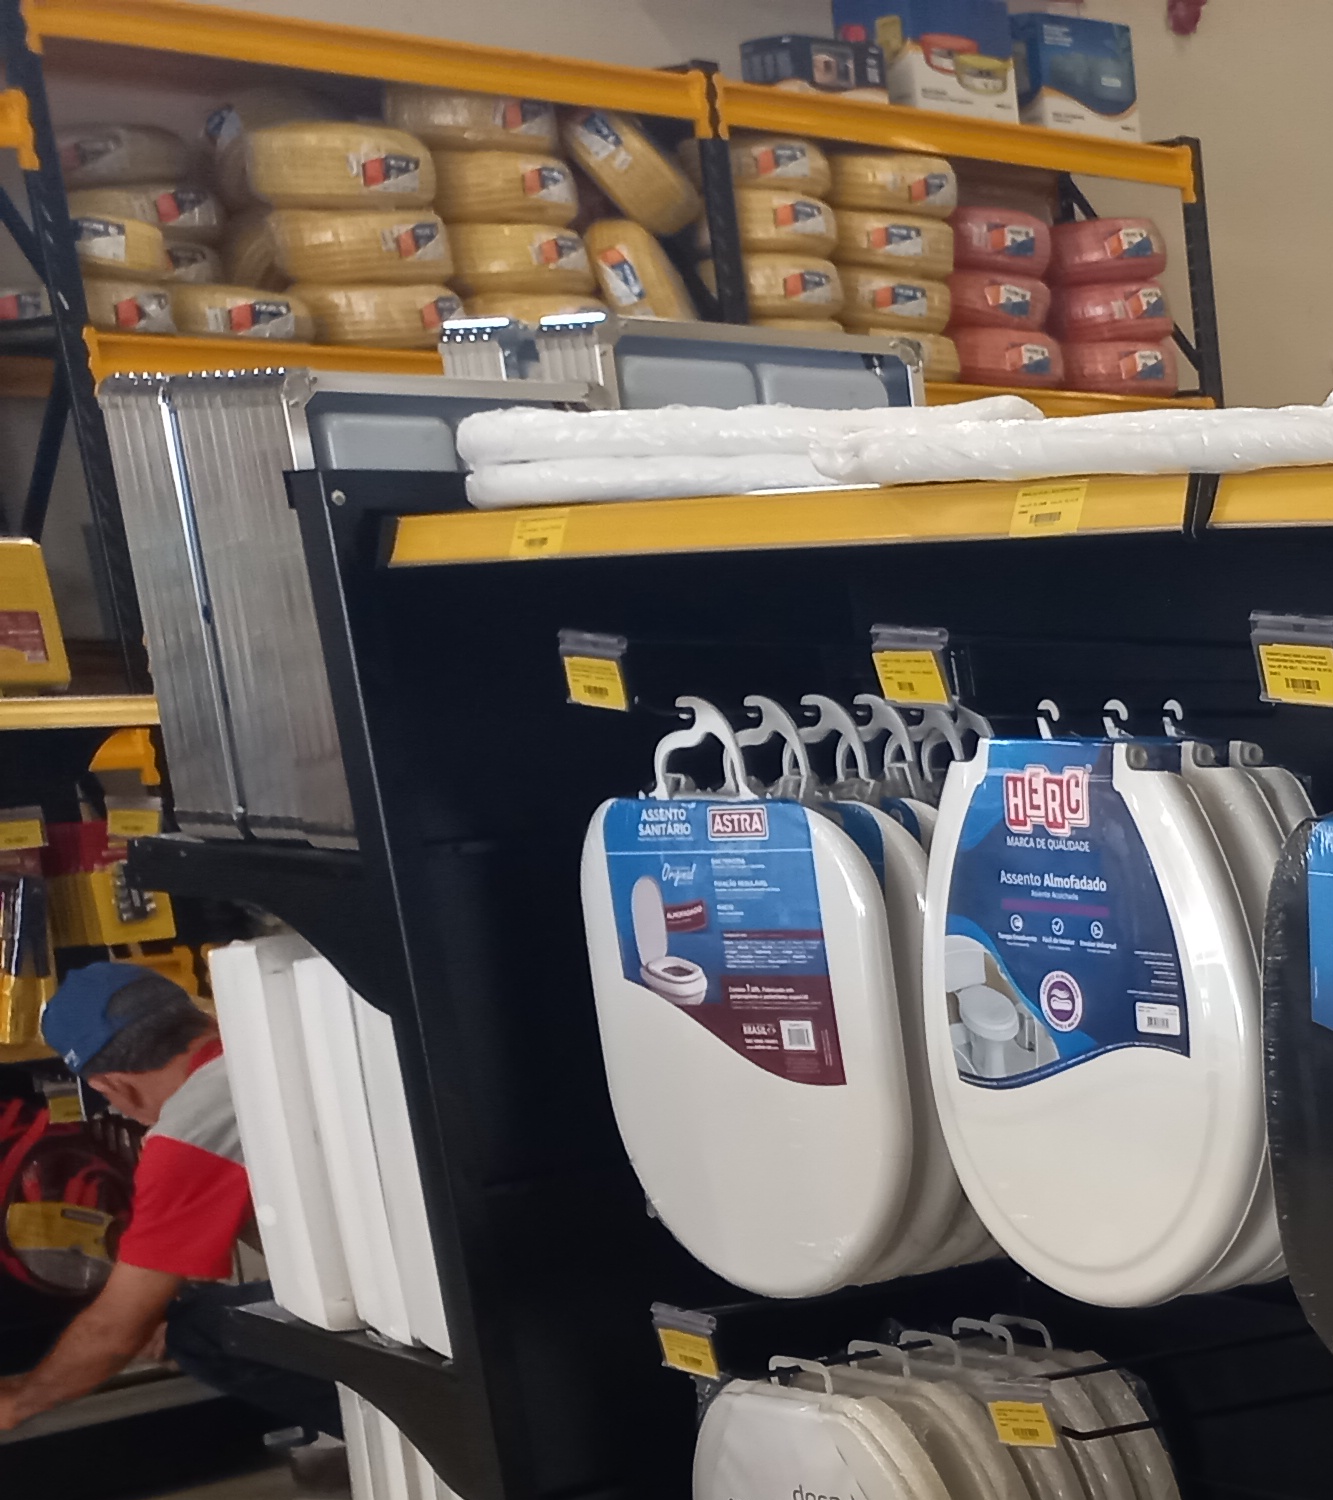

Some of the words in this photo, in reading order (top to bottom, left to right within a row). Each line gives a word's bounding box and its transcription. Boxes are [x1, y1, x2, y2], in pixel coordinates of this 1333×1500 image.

[1006, 772, 1081, 824] HERC
[641, 808, 686, 821] ASSENTO
[714, 813, 762, 832] ASTRA
[638, 822, 691, 836] SANITÁRIO
[1007, 836, 1034, 848] MARCA
[1037, 838, 1046, 849] DE
[1048, 839, 1090, 852] QUALIDADE
[1001, 870, 1041, 886] Assento
[1044, 873, 1106, 891] Almofadado
